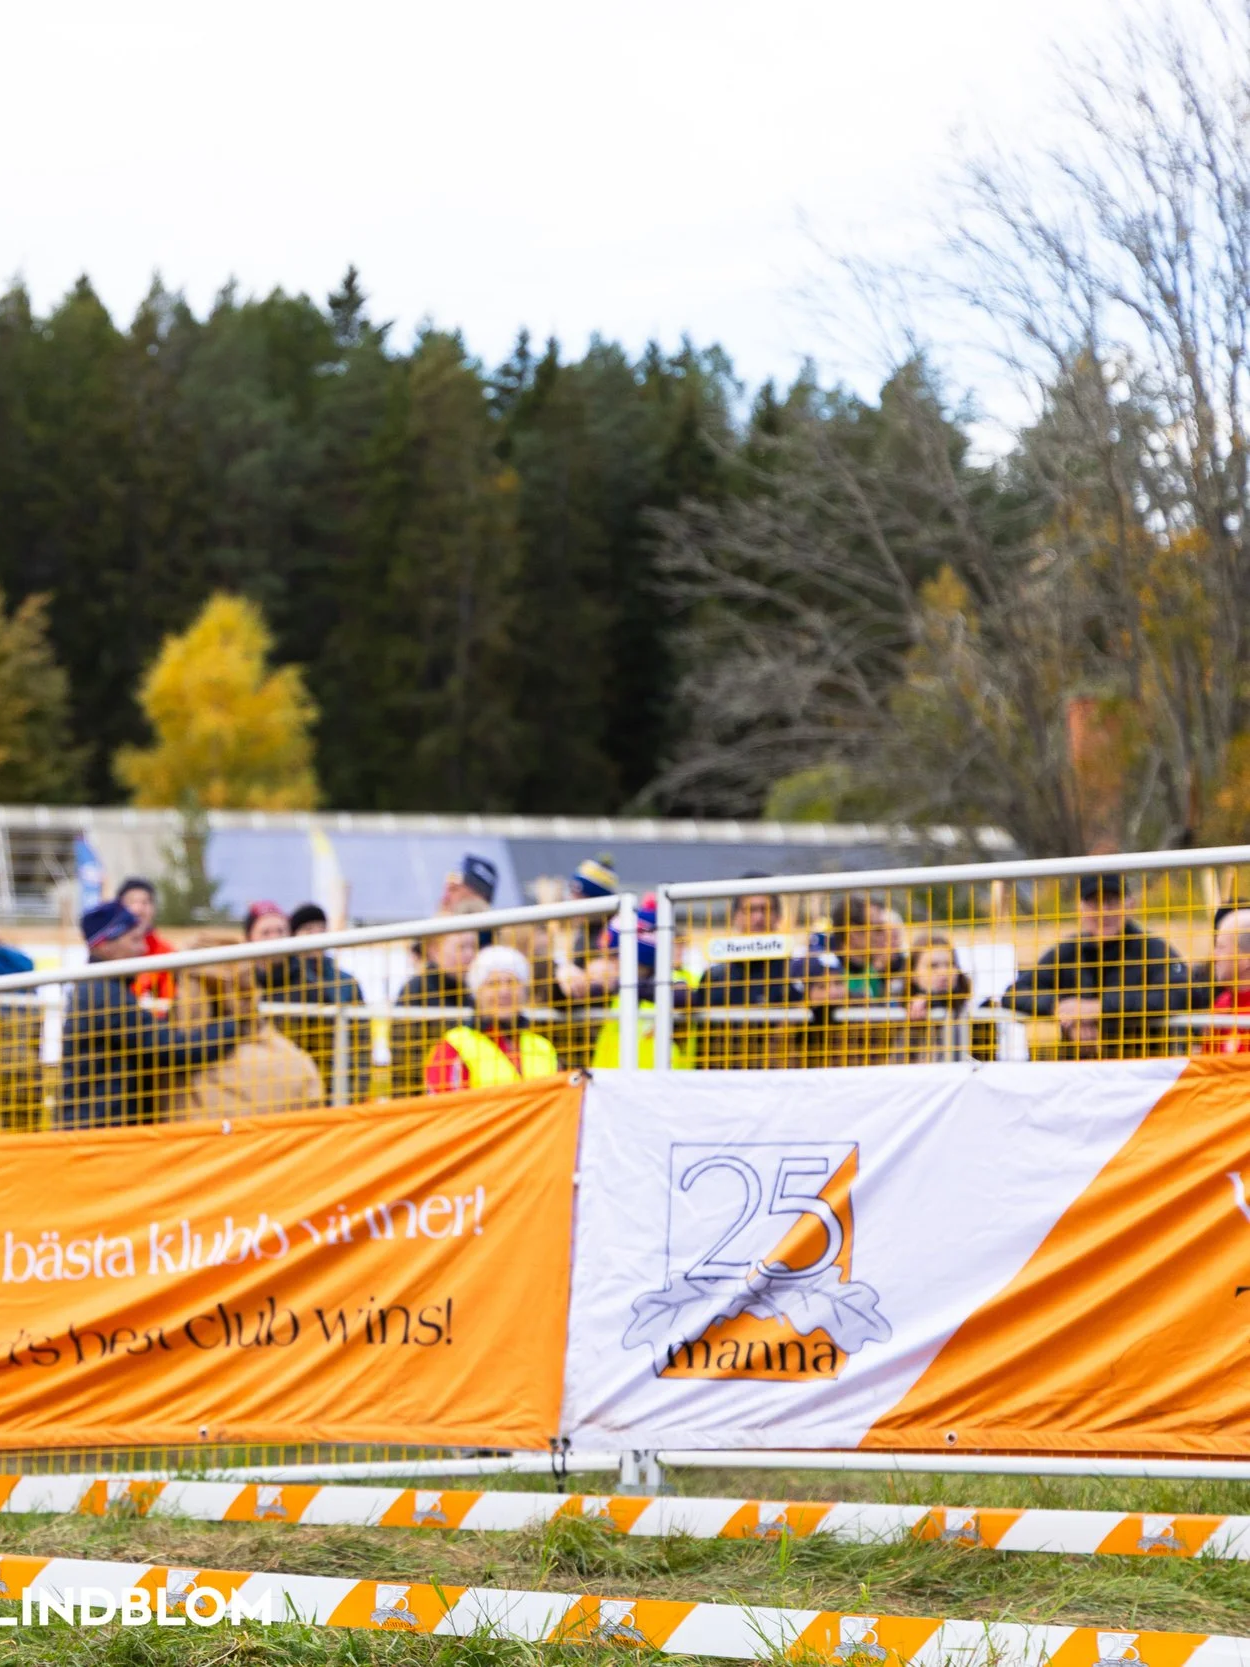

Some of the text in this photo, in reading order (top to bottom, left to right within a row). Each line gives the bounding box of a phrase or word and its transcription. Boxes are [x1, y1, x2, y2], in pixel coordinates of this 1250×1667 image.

[1, 1230, 135, 1284] bästa
[147, 1213, 290, 1275] klubb
[680, 1155, 844, 1280] 25
[184, 1296, 301, 1350] club
[315, 1294, 455, 1348] wins!
[667, 1333, 838, 1376] manna
